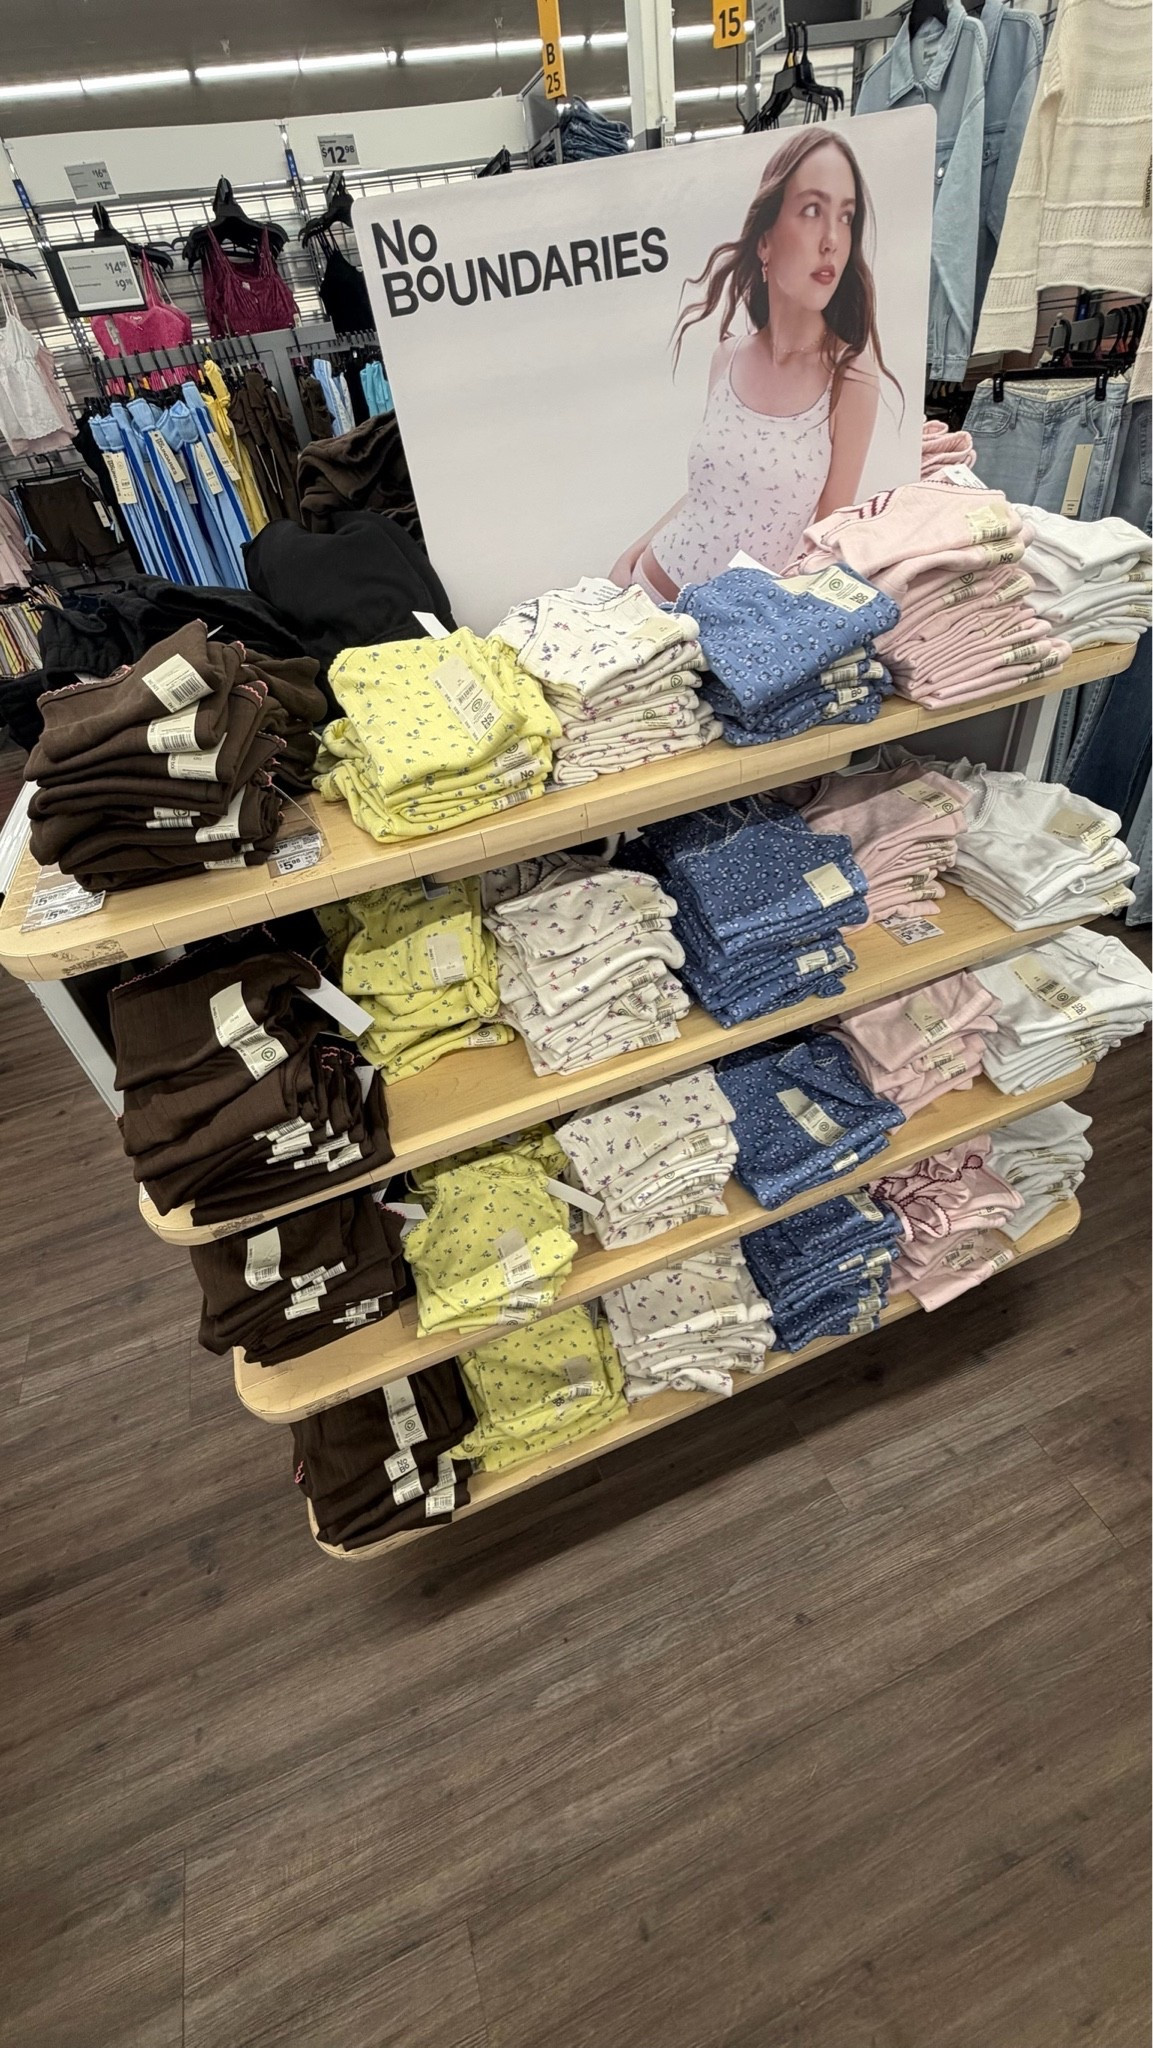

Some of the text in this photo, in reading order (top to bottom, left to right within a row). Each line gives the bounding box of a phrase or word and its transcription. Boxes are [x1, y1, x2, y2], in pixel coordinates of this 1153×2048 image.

[718, 6, 741, 39] 15
[545, 43, 556, 66] B
[546, 71, 561, 94] 25
